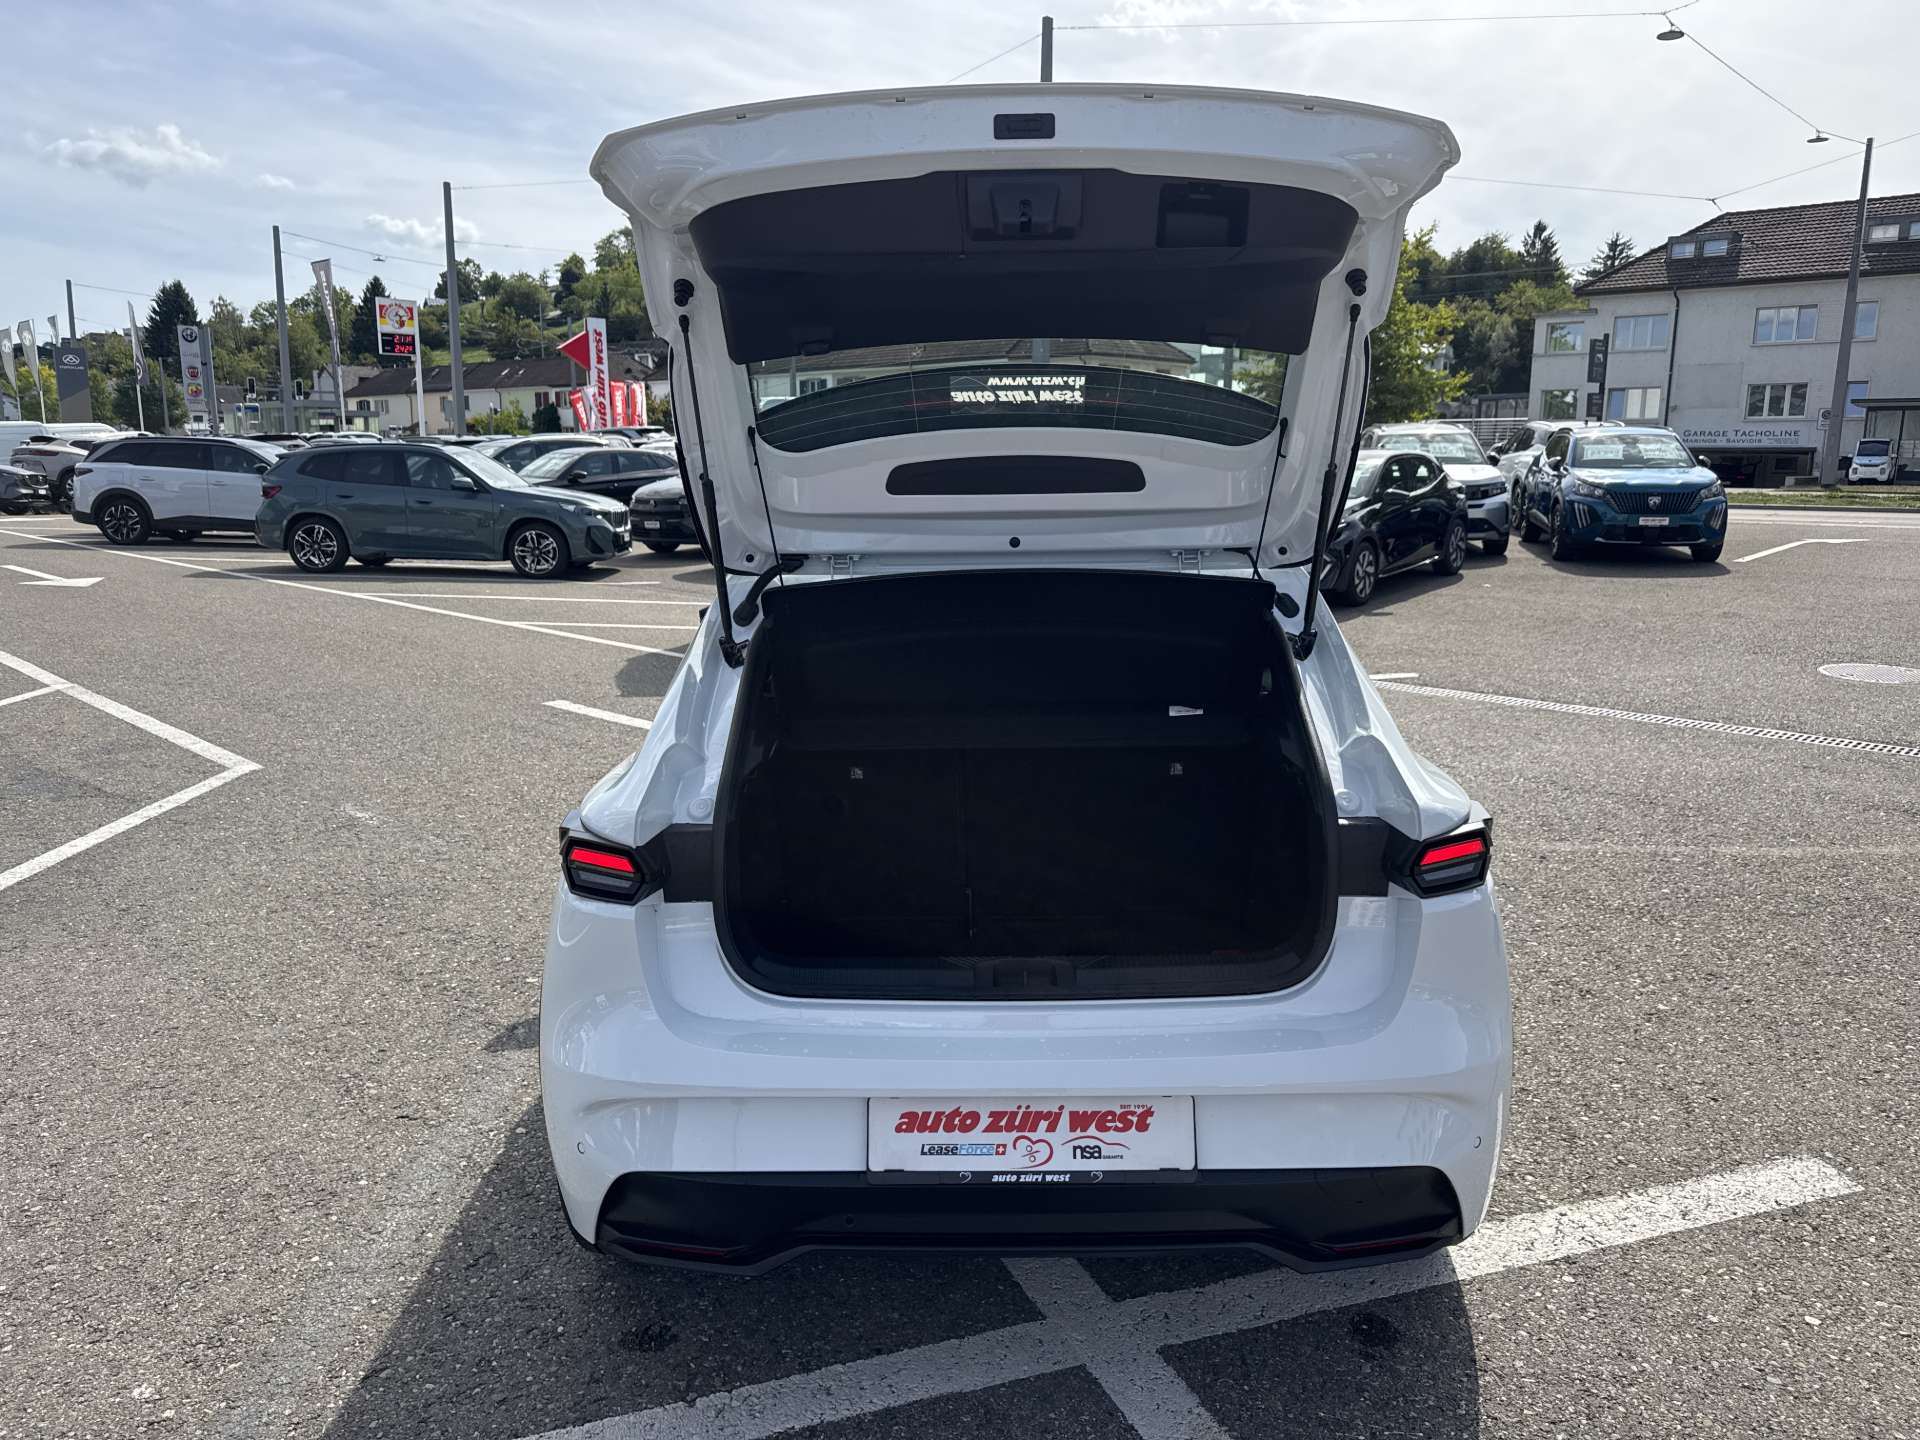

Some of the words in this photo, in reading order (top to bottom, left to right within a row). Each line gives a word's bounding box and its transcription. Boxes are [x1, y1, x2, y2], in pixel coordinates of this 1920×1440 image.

[594, 329, 604, 365] west
[1683, 430, 1729, 438] GARAGE
[1733, 429, 1800, 438] TACHOLINE
[894, 1105, 981, 1133] auto
[981, 1104, 1065, 1133] züri
[1068, 1105, 1155, 1133] west
[920, 1143, 995, 1156] LeaseForce
[1072, 1145, 1102, 1159] nsa
[991, 1173, 1017, 1182] auto
[1020, 1173, 1043, 1182] züri
[1045, 1173, 1071, 1182] west
